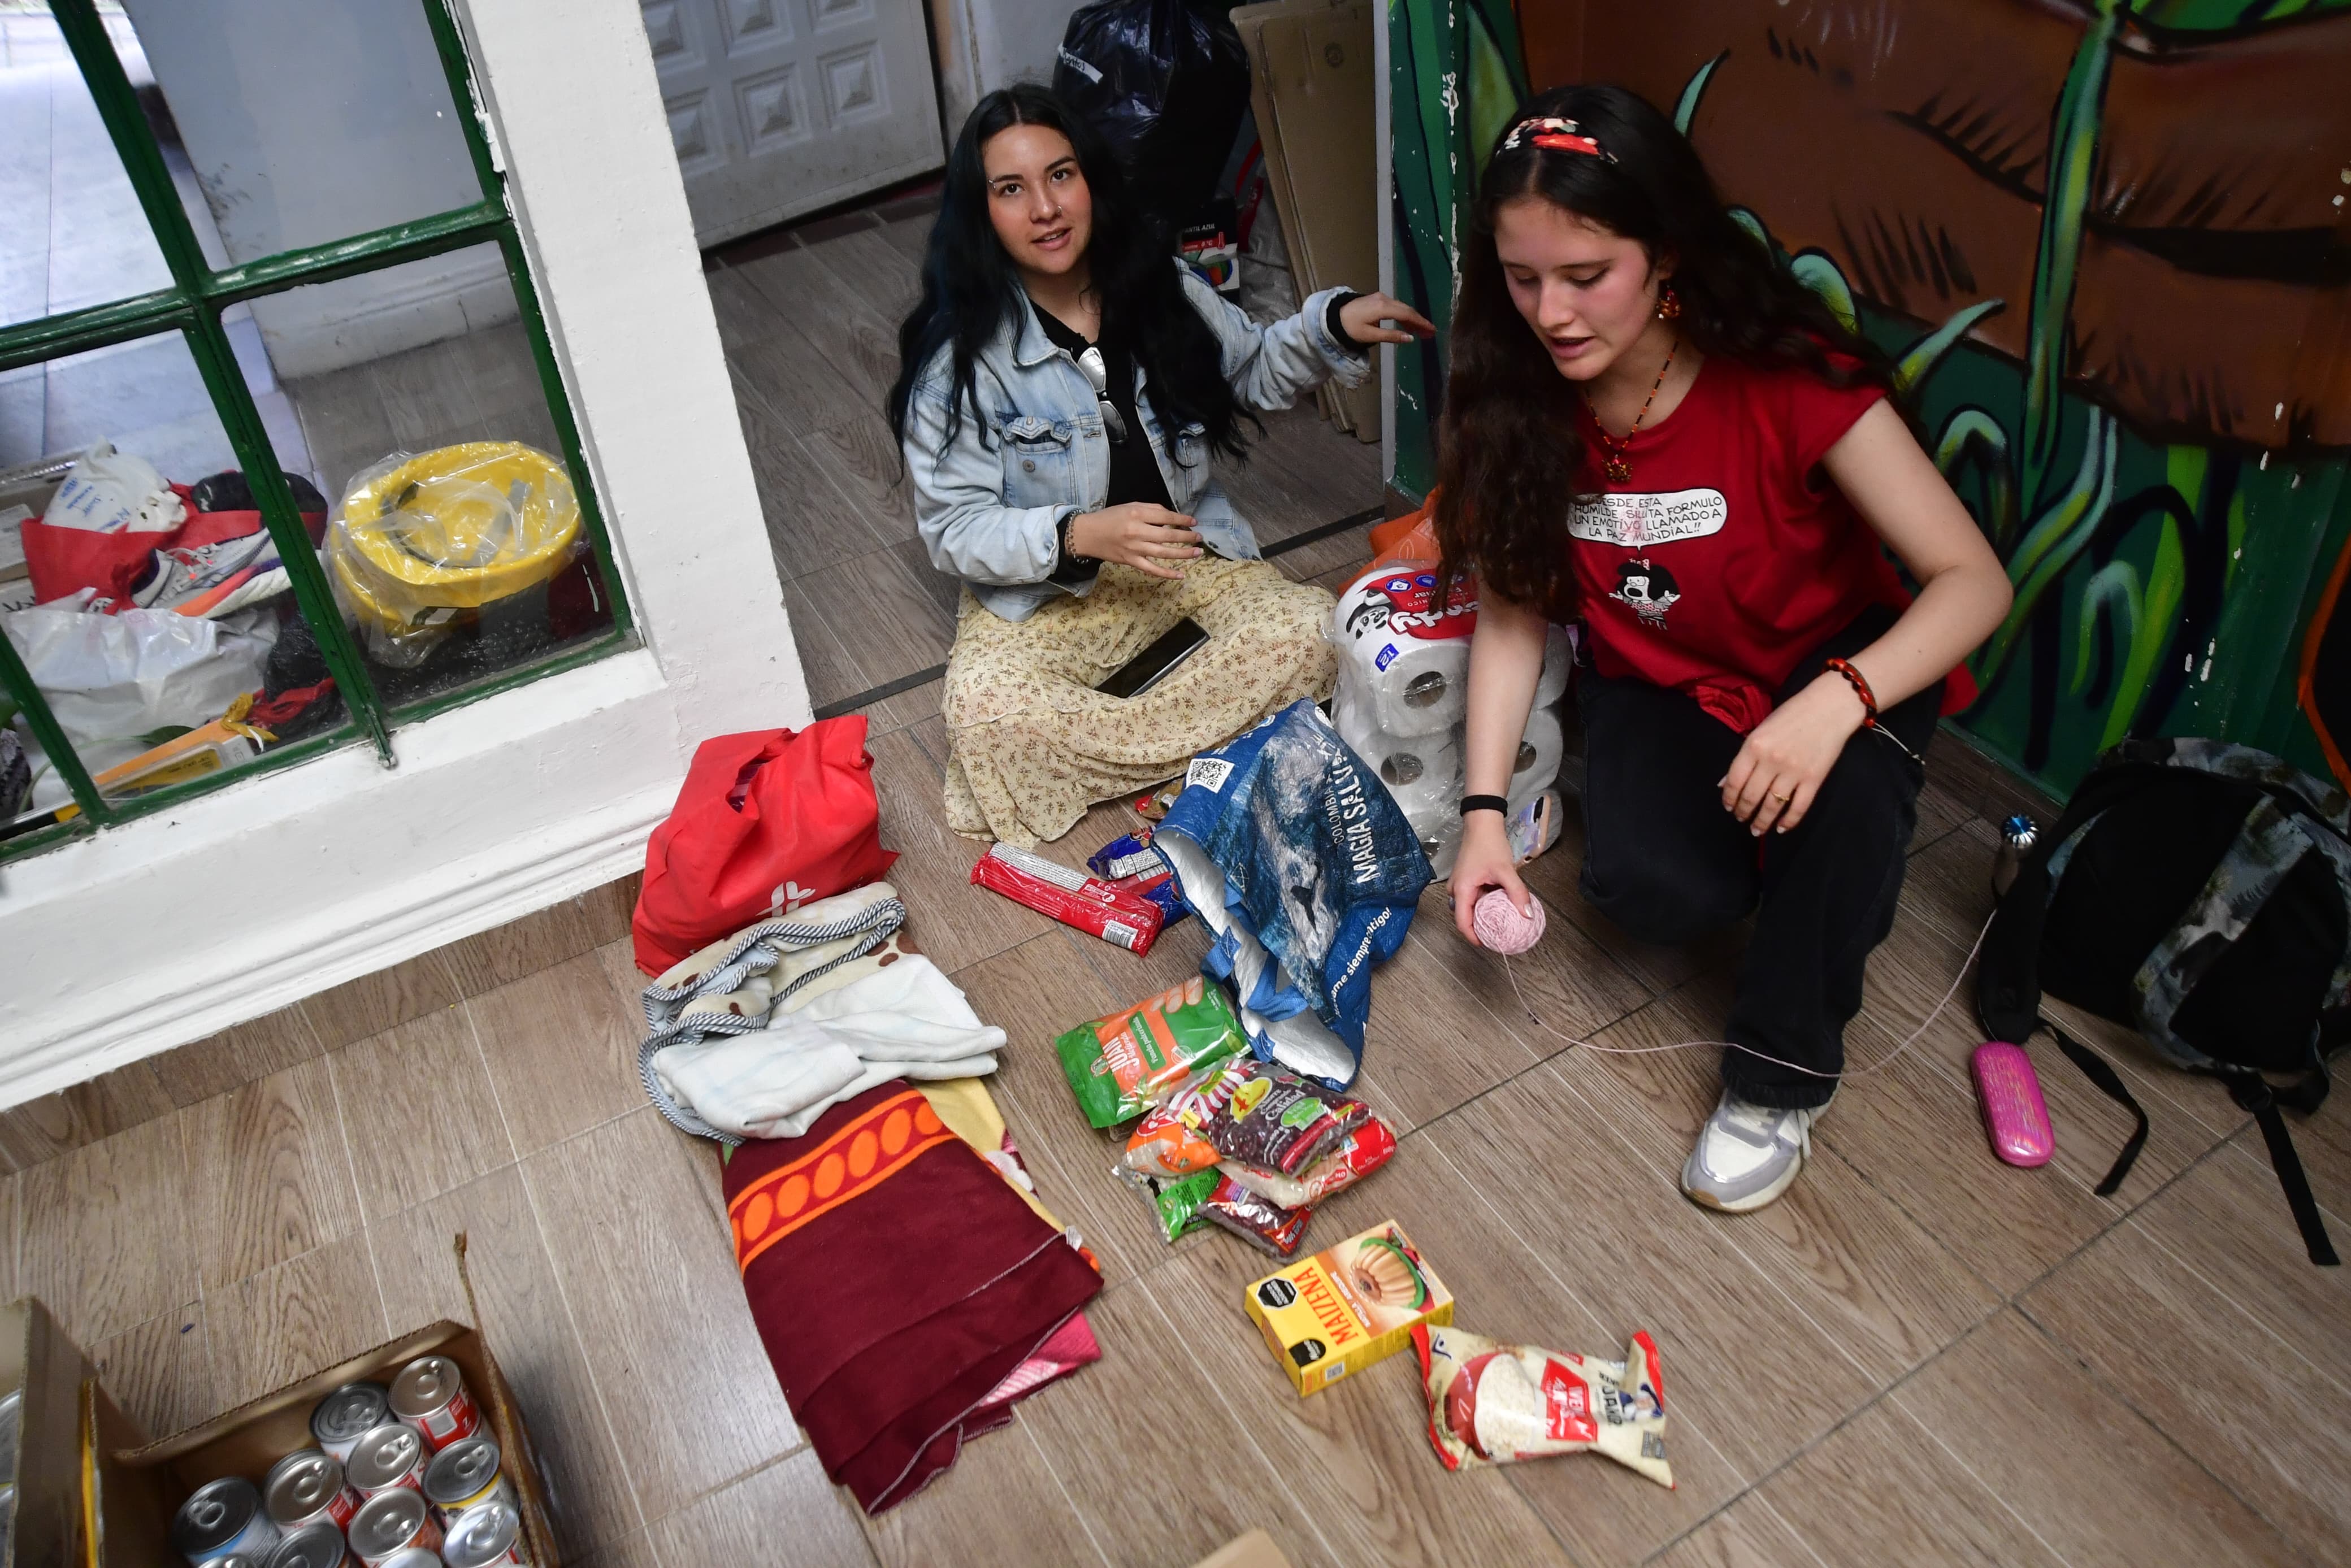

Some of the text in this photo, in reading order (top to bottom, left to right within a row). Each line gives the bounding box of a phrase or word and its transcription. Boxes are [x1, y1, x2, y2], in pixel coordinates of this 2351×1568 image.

[1574, 508, 1723, 531] UN EMOTIVO LLAMADO A
[1639, 497, 1662, 508] ESTA
[1667, 496, 1723, 515] FORMULO
[1589, 528, 1603, 537] LA
[1607, 528, 1627, 542] PAZ
[1323, 786, 1345, 844] COLOMBIA
[1344, 818, 1381, 884] MAGIA
[1342, 935, 1373, 976] siempre
[1103, 1036, 1139, 1072] JUAN
[1264, 1088, 1306, 1122] Calidad
[1292, 1266, 1360, 1346] MAIZENA
